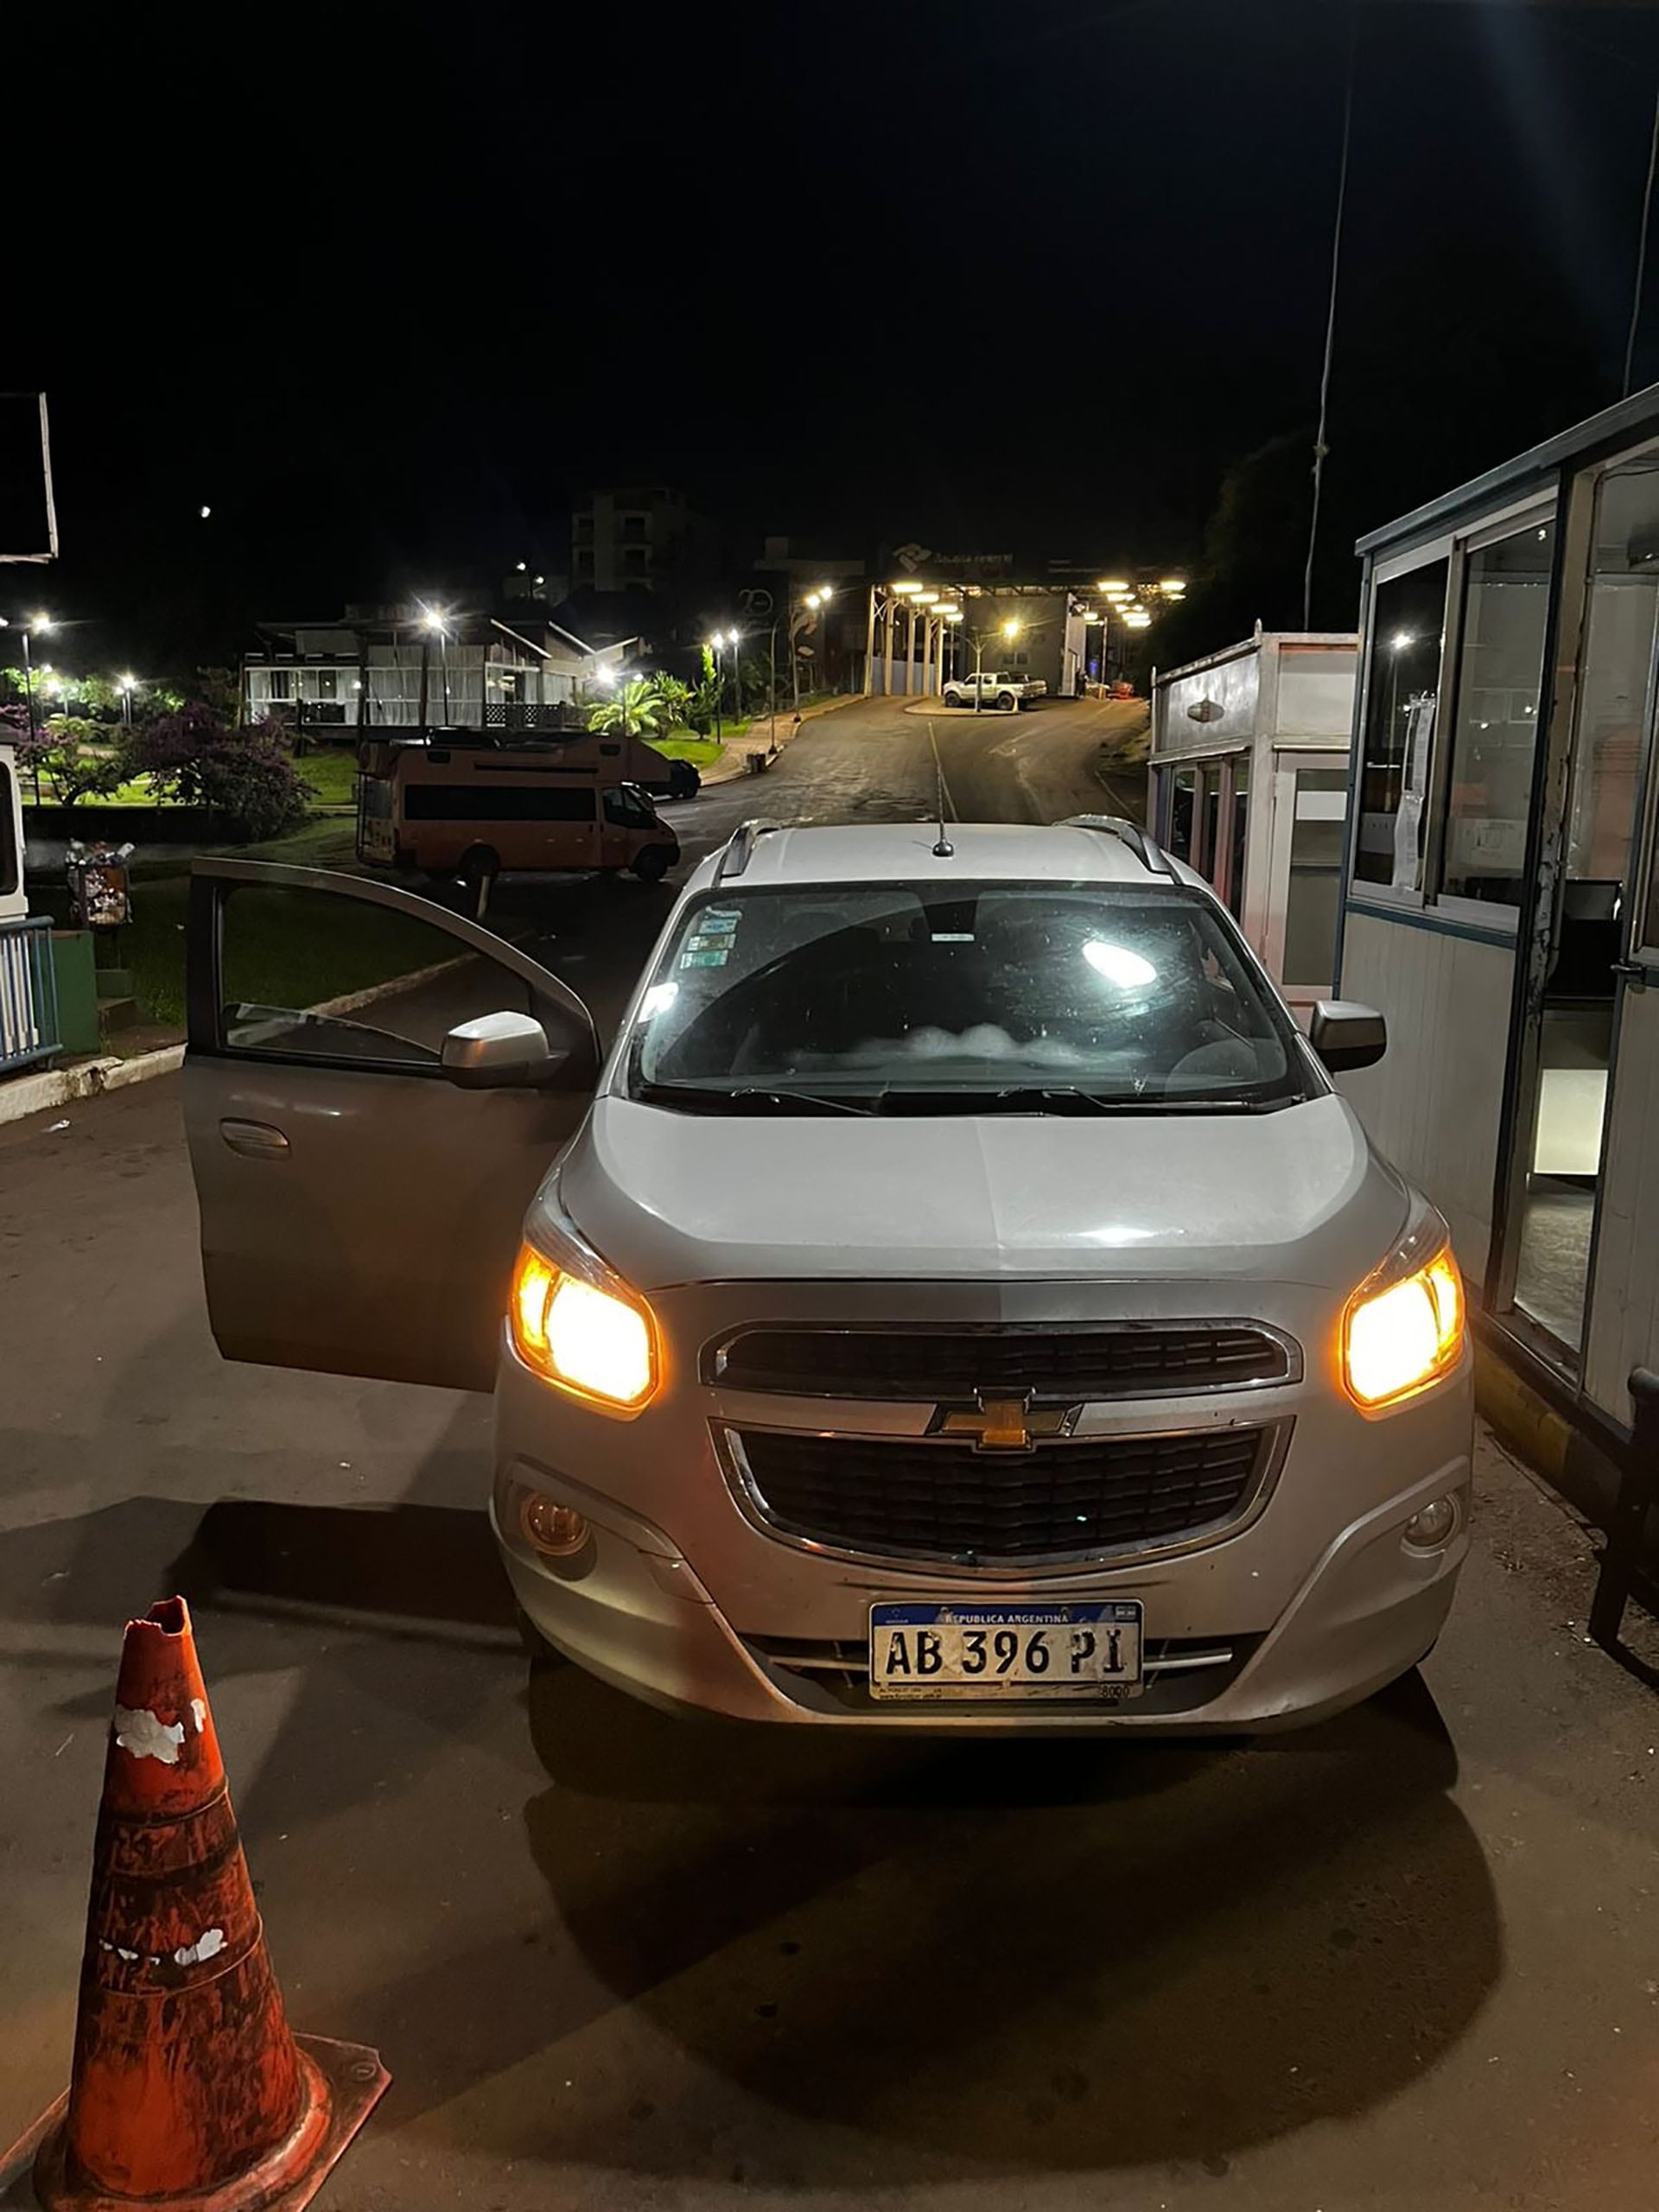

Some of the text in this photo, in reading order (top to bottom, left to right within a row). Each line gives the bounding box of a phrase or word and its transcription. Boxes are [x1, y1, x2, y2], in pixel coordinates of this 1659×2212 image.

[945, 1614, 1069, 1624] REPUBLICA ARGENTINA
[886, 1629, 1125, 1675] AB 396 PI
